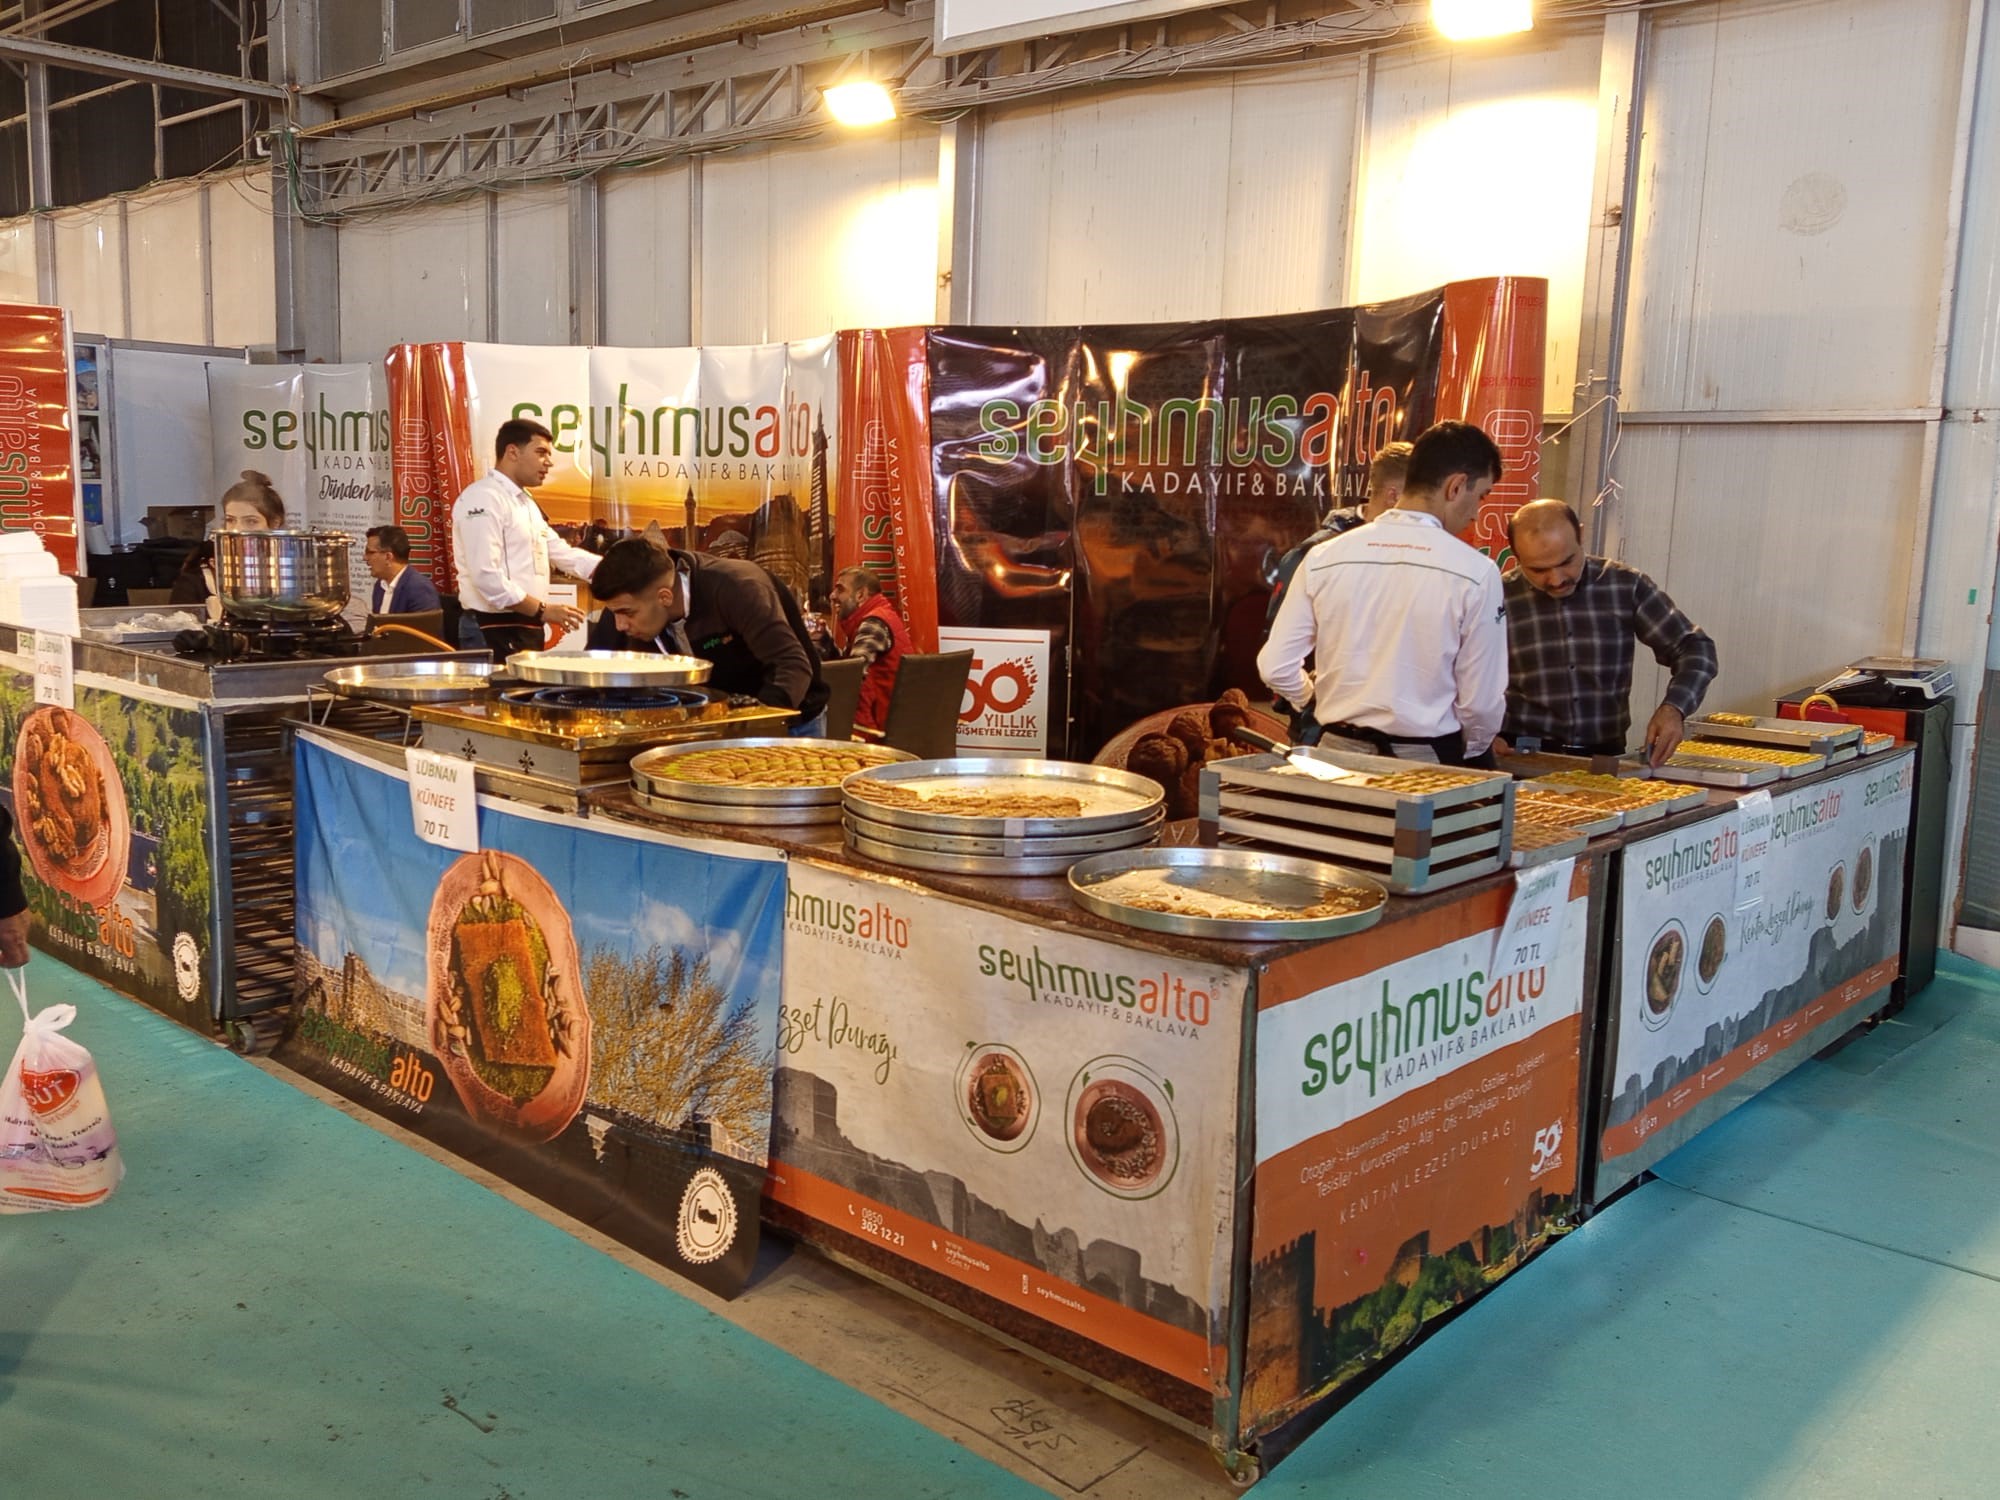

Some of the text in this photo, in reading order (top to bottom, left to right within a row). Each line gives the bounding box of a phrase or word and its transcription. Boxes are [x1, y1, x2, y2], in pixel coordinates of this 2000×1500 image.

[319, 474, 373, 502] Dünden
[984, 714, 1037, 729] YILLIK
[1004, 729, 1039, 738] LEZZET
[416, 788, 455, 811] KÜNEFE
[423, 819, 449, 839] 70 TL
[1645, 825, 1738, 895] seyhmusalto
[847, 936, 902, 959] BAKLAVA
[1513, 942, 1541, 966] 70 TL
[978, 944, 1211, 1026] seyhmusalto
[1125, 1011, 1200, 1041] BAKLAVA
[1470, 1004, 1536, 1049] BAKLAVA
[1530, 1118, 1562, 1174] 50
[861, 1207, 883, 1225] 0850
[860, 1218, 905, 1247] 302 12 21
